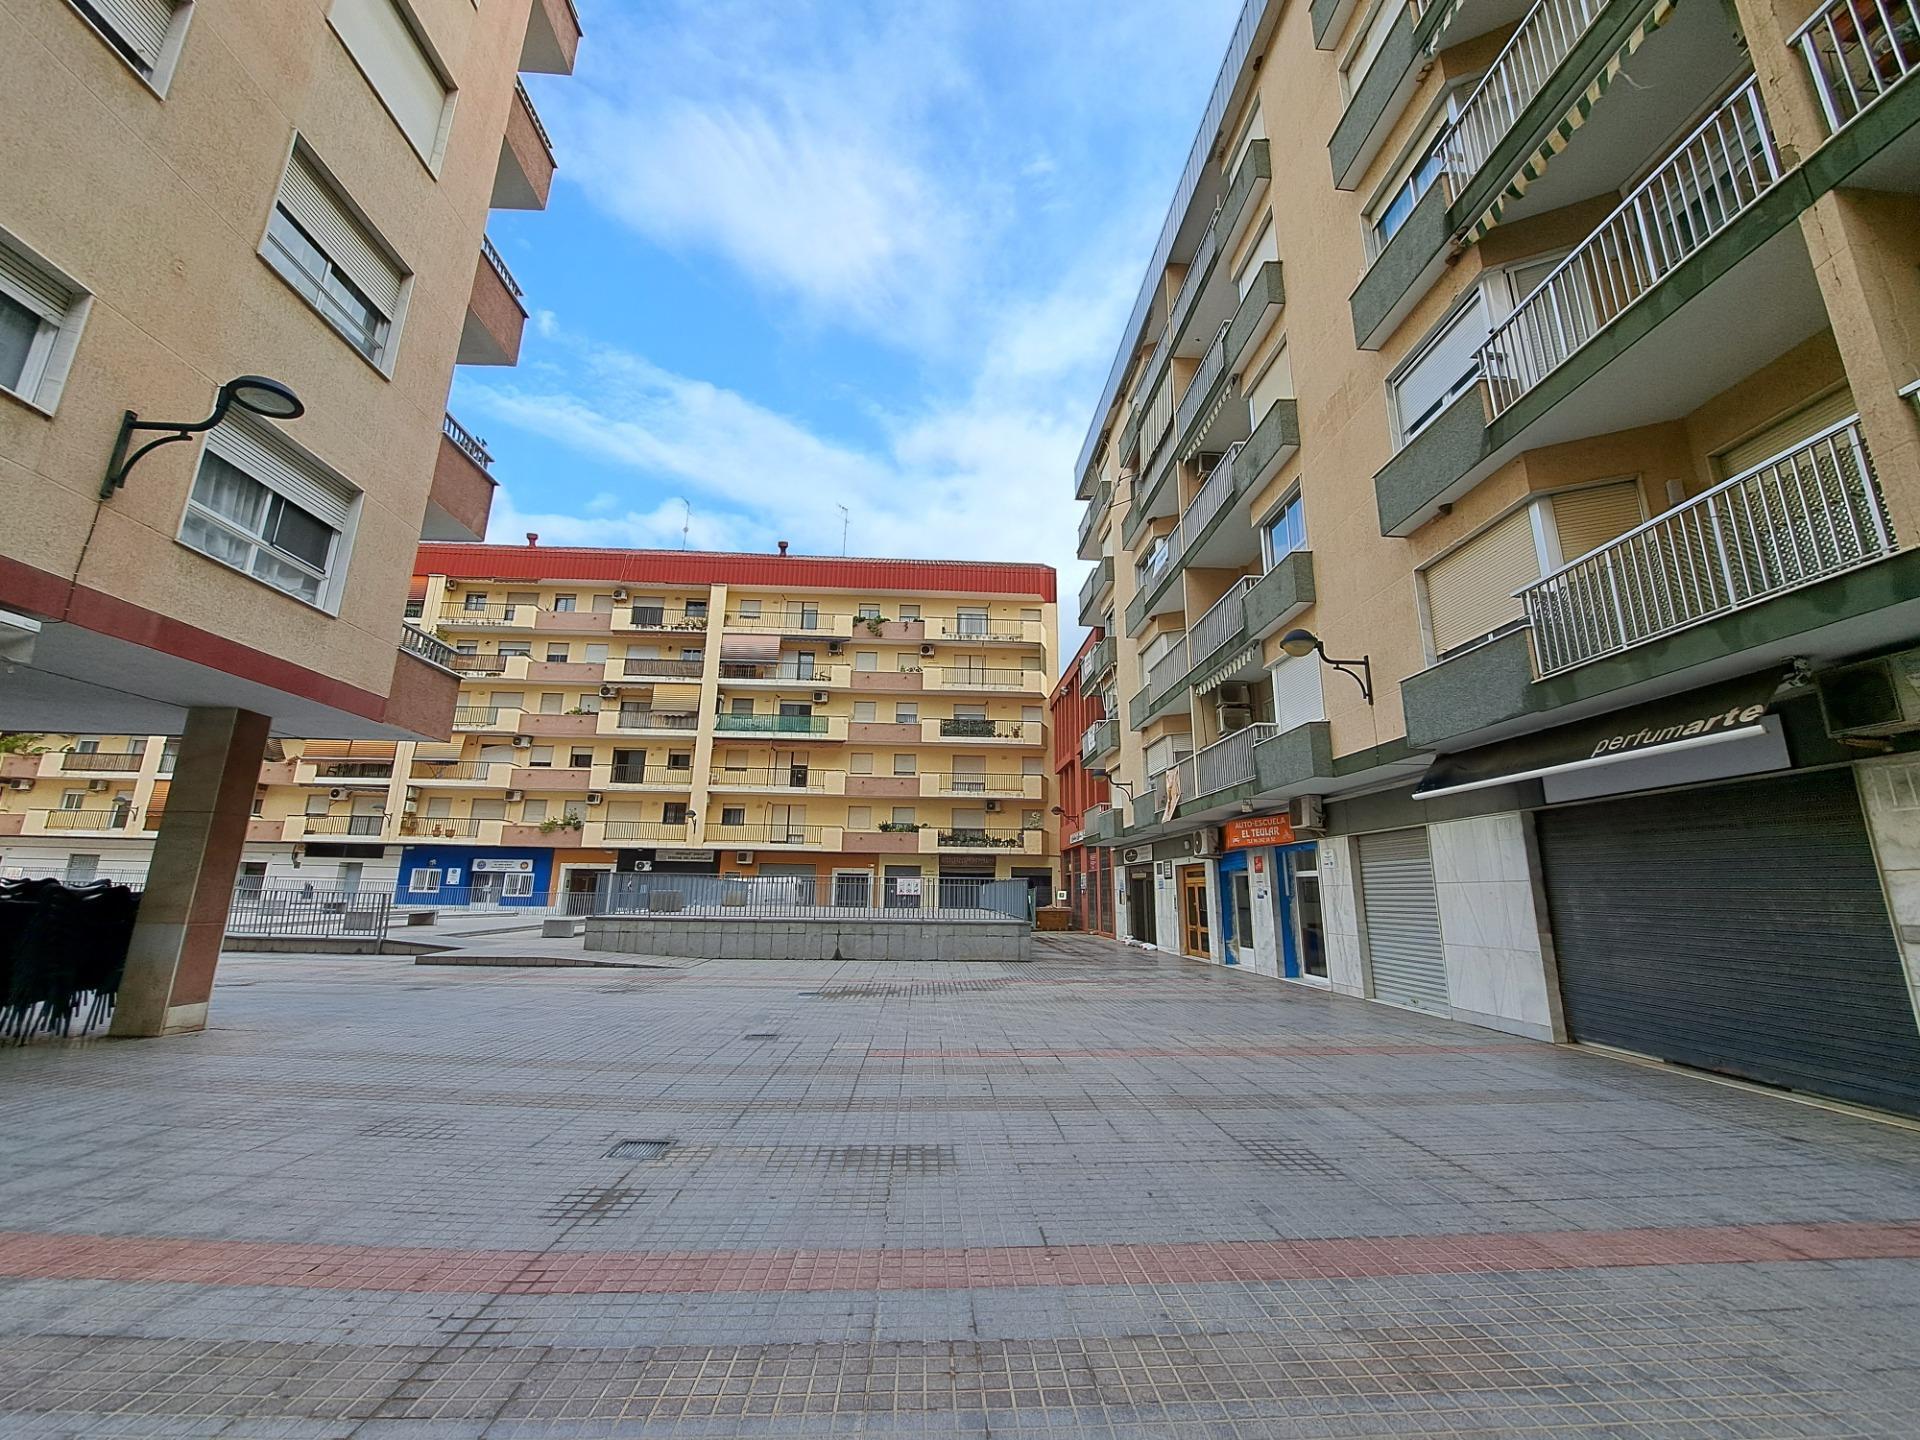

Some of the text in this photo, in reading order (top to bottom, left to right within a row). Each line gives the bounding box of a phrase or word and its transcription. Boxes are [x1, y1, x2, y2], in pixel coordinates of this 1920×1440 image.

[1591, 704, 1764, 758] perfumarte
[1235, 817, 1286, 829] AUTO-ESCUELA
[1241, 829, 1250, 838] EL
